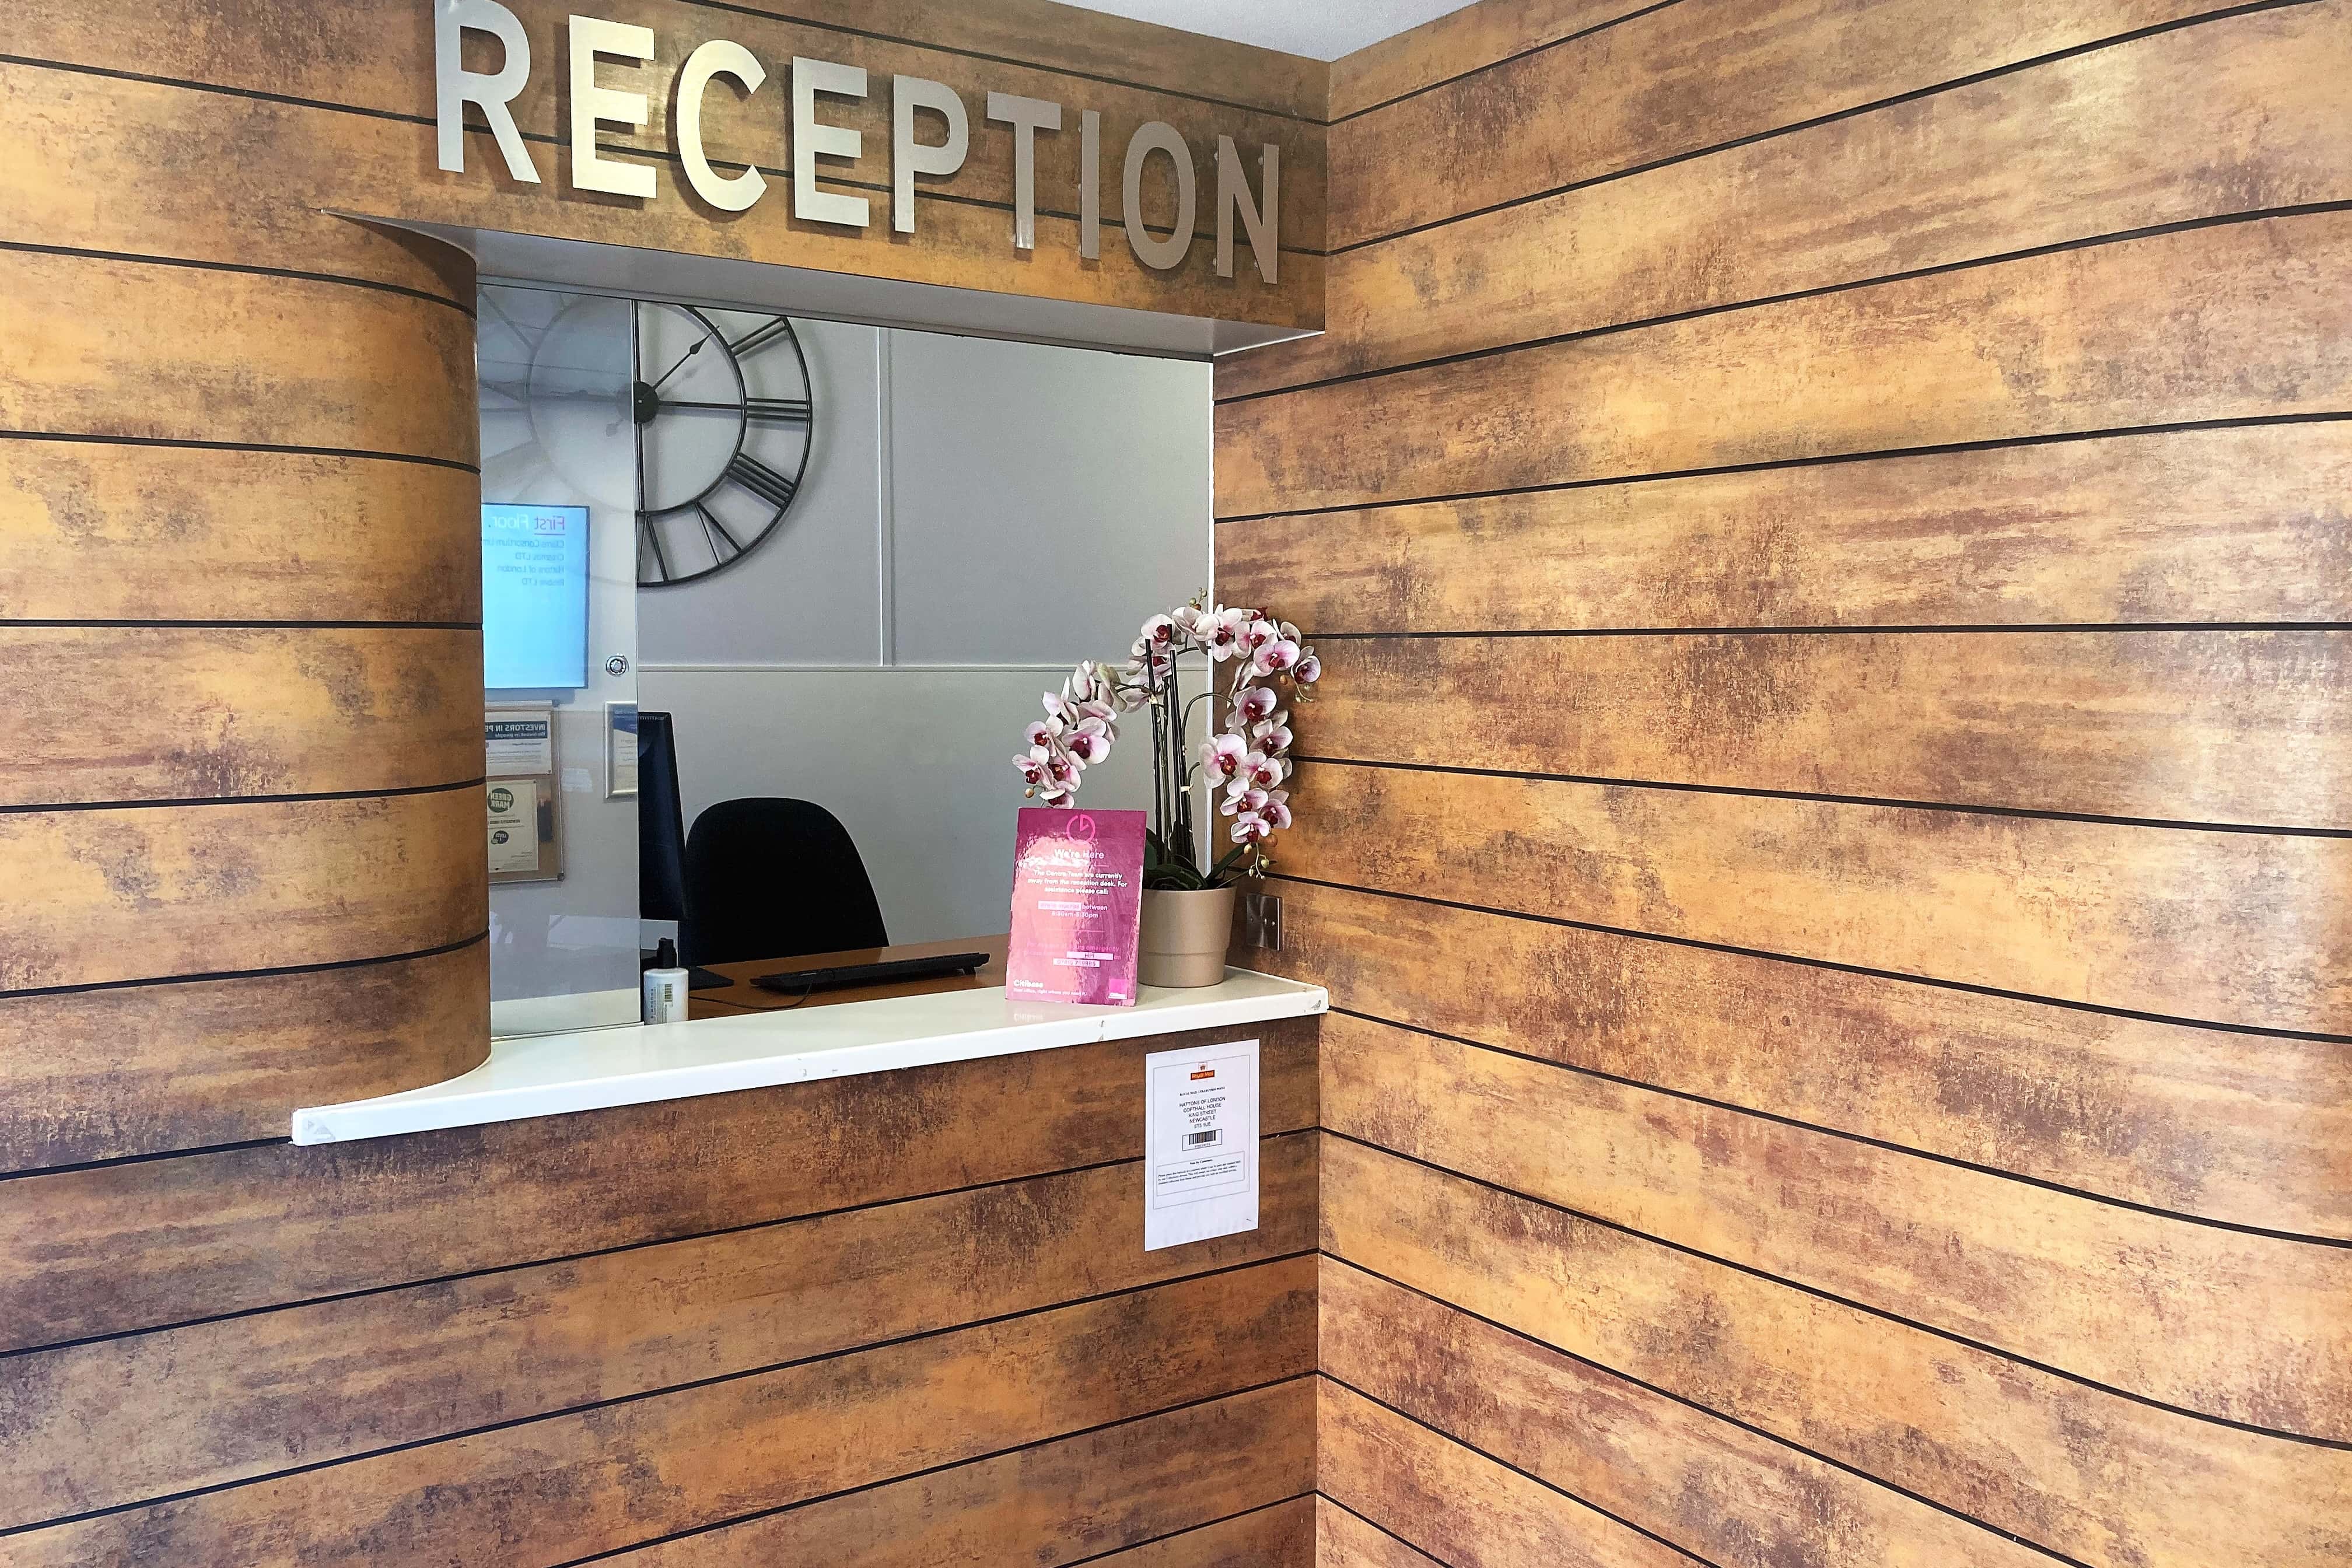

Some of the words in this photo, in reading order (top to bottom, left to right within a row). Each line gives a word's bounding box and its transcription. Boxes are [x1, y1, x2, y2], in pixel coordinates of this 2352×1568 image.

[434, 0, 1279, 285] RECEPTION
[1054, 849, 1080, 859] We're
[1083, 849, 1104, 859] Here
[1189, 1115, 1216, 1124] NEWCASTLE
